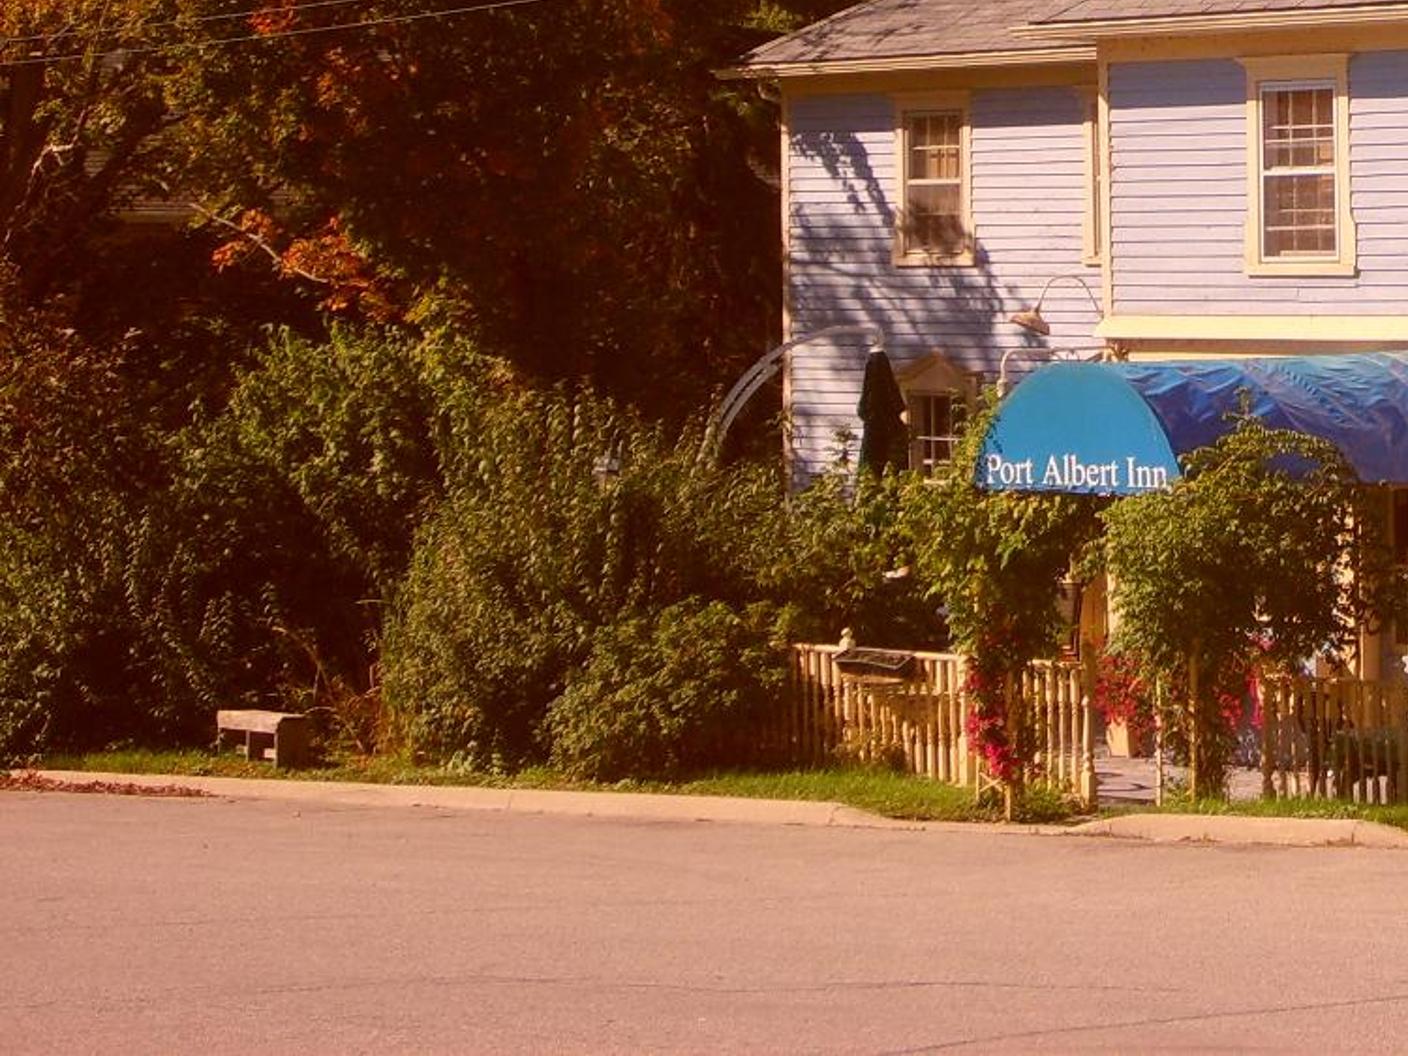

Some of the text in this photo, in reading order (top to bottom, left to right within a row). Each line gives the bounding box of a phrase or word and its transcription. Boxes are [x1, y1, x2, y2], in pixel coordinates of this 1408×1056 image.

[987, 454, 1168, 488] Port Albert Inn
